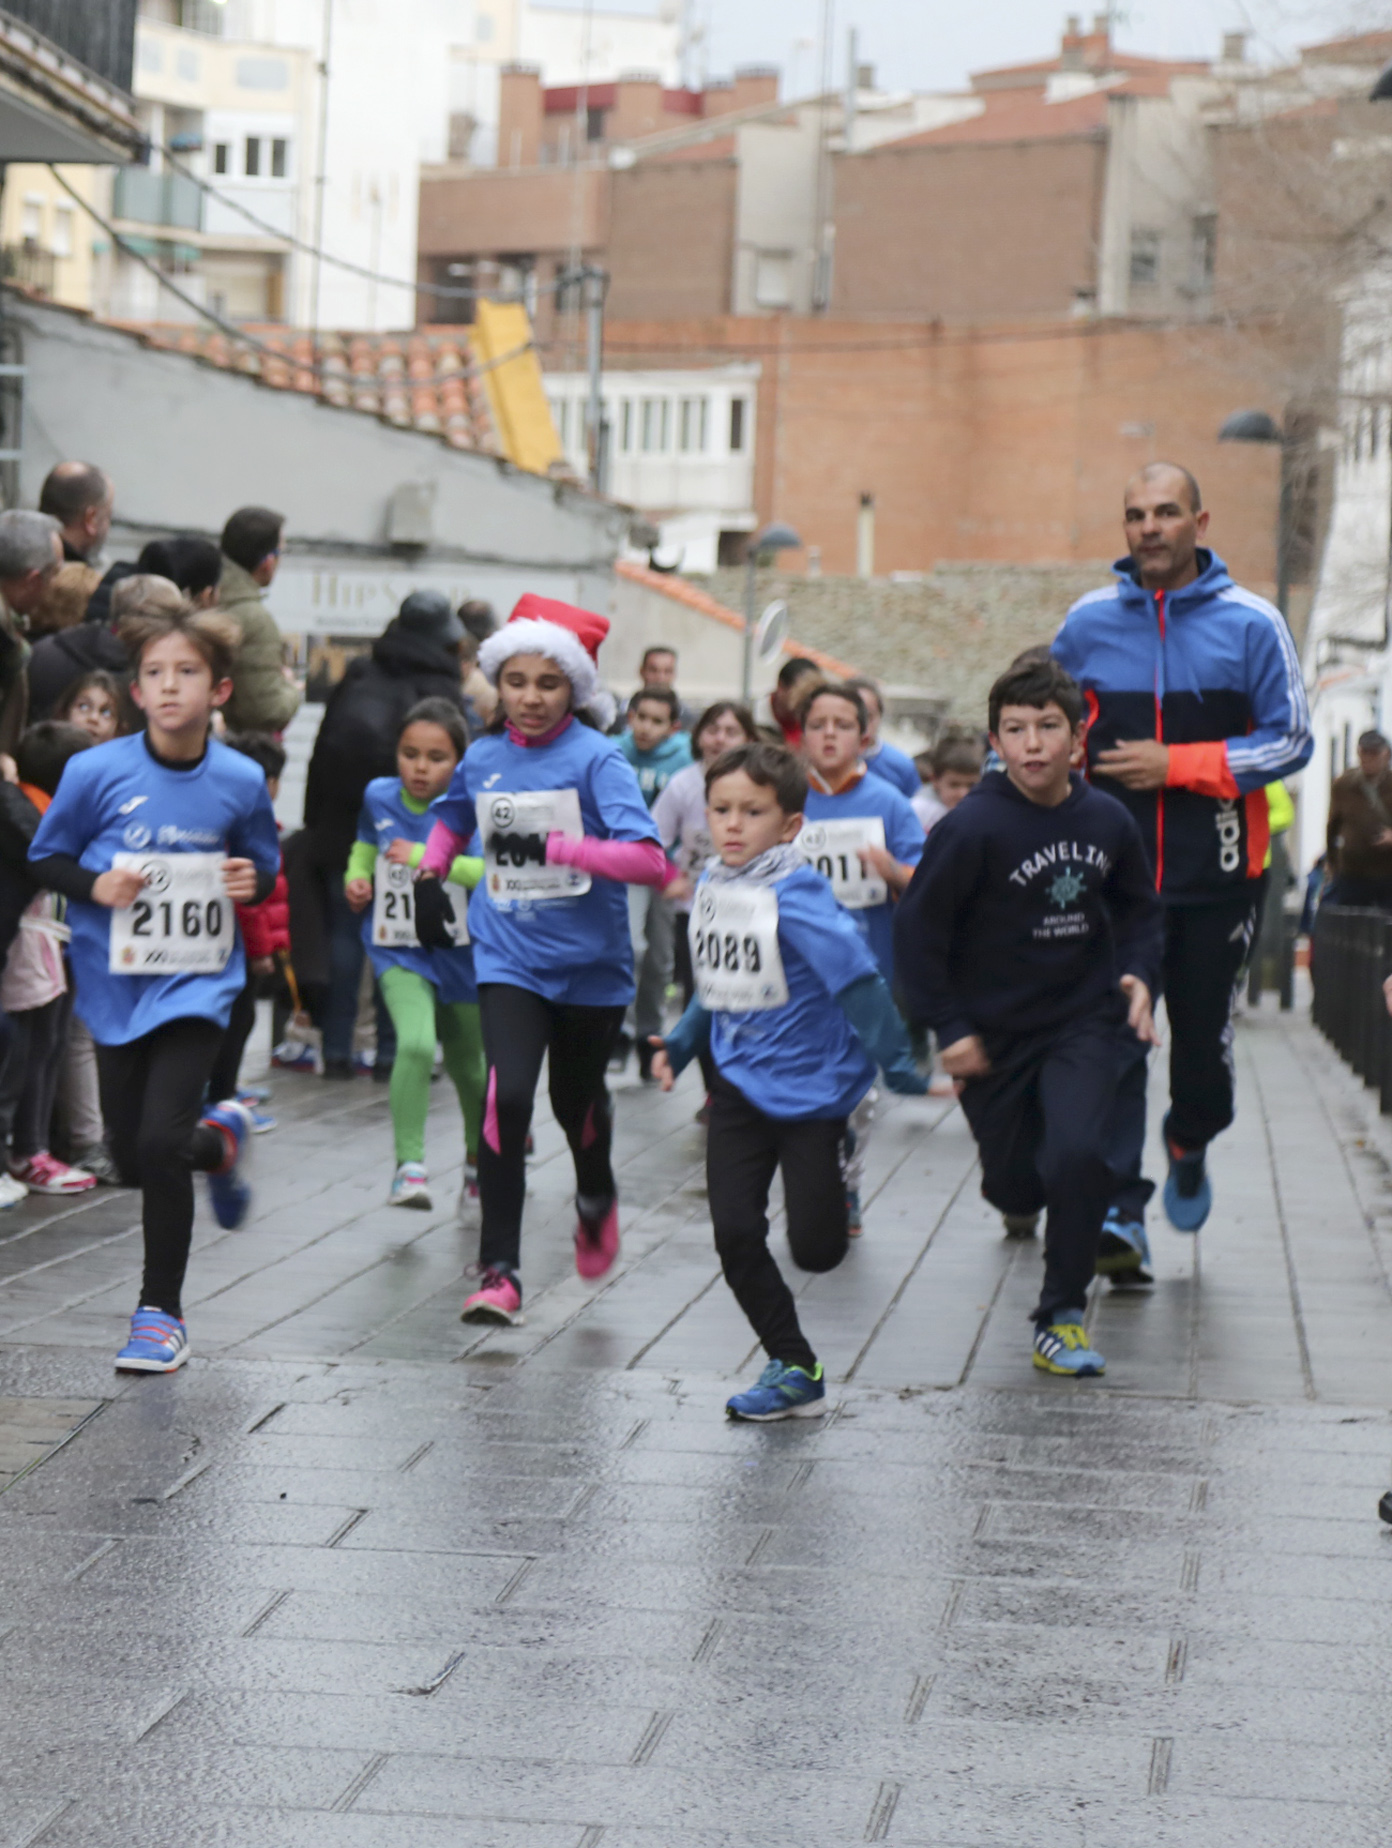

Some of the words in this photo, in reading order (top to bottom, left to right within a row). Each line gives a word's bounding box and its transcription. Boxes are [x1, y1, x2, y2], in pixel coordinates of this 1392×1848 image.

[130, 900, 223, 937] 2160
[1033, 928, 1051, 938] THE
[1053, 923, 1089, 937] WORLD
[1043, 912, 1086, 926] AROUND
[694, 929, 762, 973] 2089
